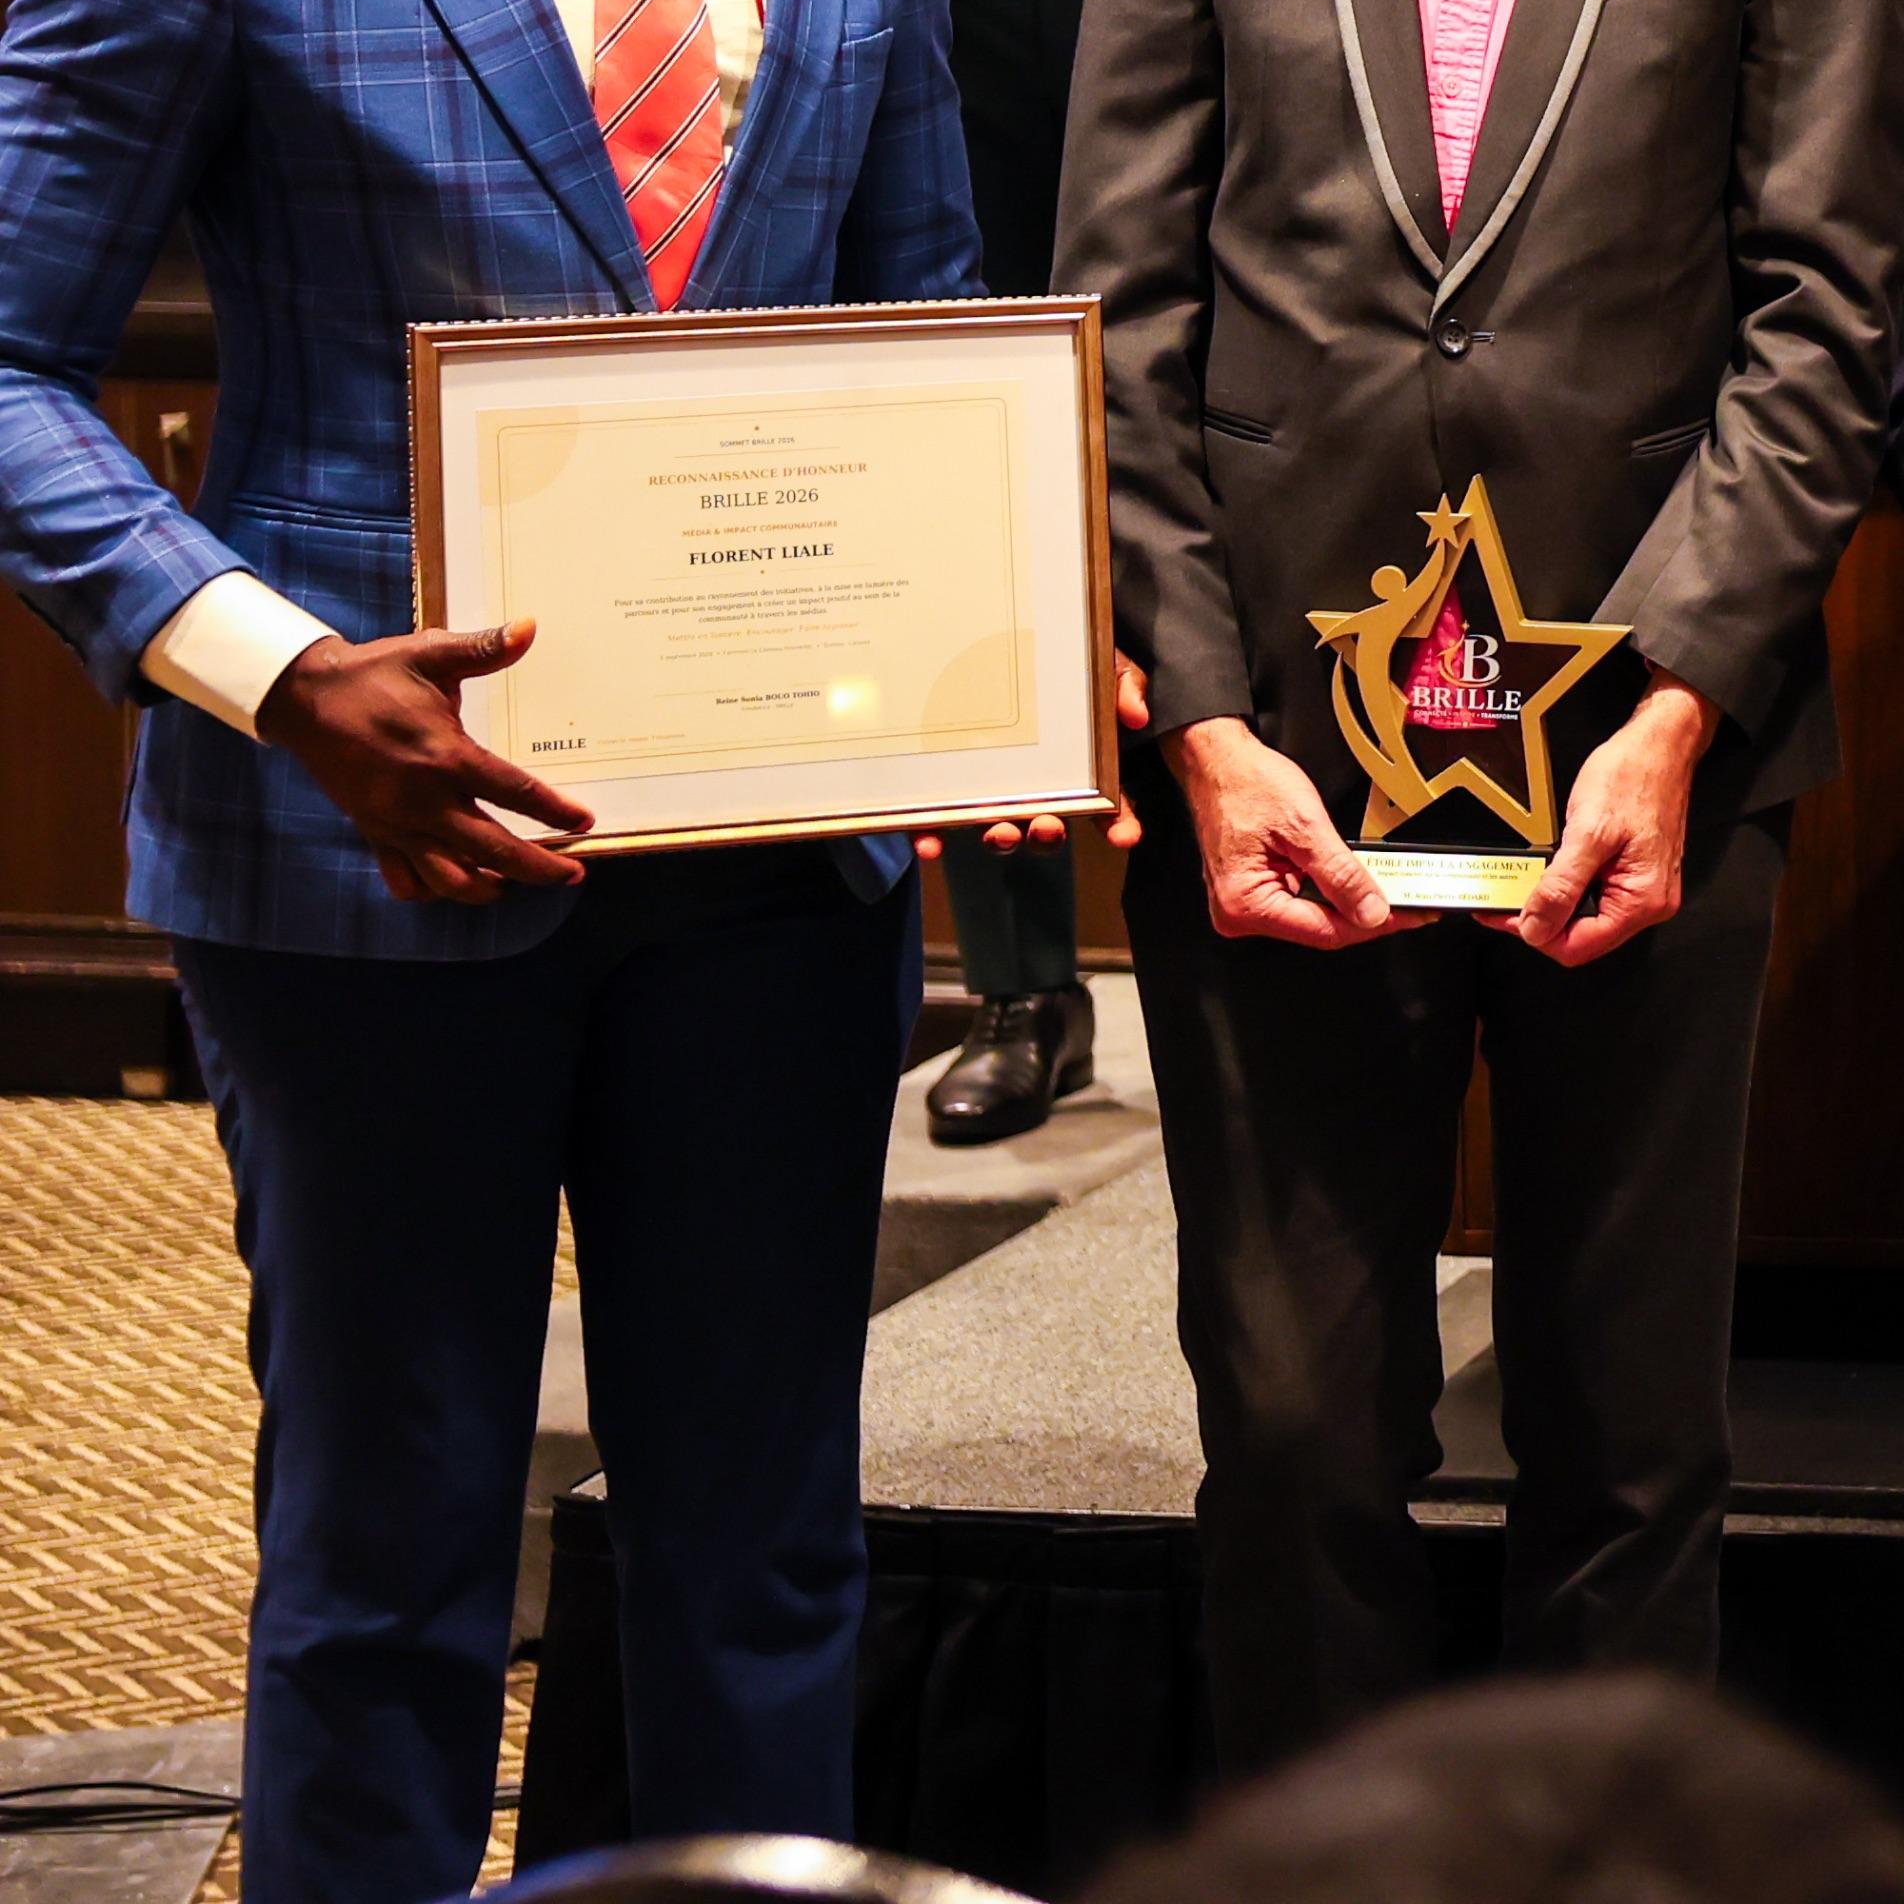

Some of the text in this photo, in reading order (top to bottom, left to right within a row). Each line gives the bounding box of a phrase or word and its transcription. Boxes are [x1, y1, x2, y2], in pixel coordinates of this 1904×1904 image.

[720, 438, 750, 448] SOMMET
[752, 437, 775, 446] BRILLE
[648, 462, 868, 486] RECONNAISSANCE D'HONNEUR
[700, 488, 819, 510] BRILLE 2026
[714, 528, 721, 536] &
[723, 525, 757, 534] IMPACT
[759, 520, 838, 533] COMMUNAUTAIRE
[689, 543, 834, 566] FLORENT LIALE
[614, 599, 633, 608] Pour
[645, 594, 694, 605] contribution
[624, 609, 659, 618] parcours
[672, 607, 690, 616] pour
[707, 602, 755, 612] engagement
[798, 597, 825, 606] impact
[698, 613, 748, 623] communauté
[757, 611, 785, 619] travers
[741, 695, 763, 703] Sonia
[1412, 686, 1522, 712] BRILLE
[1481, 712, 1518, 721] TRANSFORME
[532, 737, 587, 752] BRILLE
[1459, 860, 1531, 872] ENGAGEMENT
